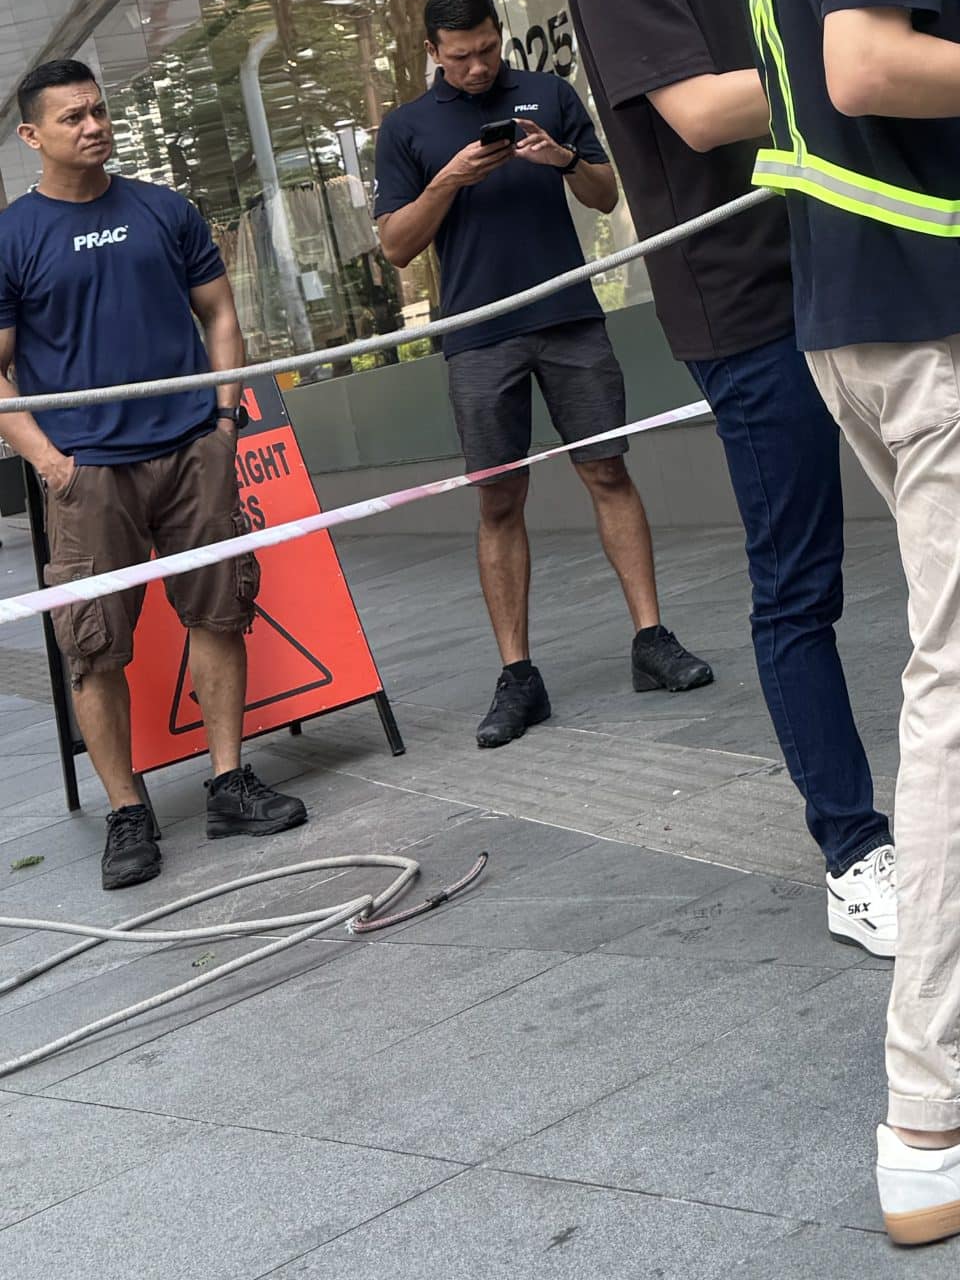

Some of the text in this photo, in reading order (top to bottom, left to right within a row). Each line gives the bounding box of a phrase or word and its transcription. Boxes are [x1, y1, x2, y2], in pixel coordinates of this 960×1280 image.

[73, 226, 128, 252] PRAC
[235, 442, 290, 488] IGHT
[848, 902, 871, 915] SKX
